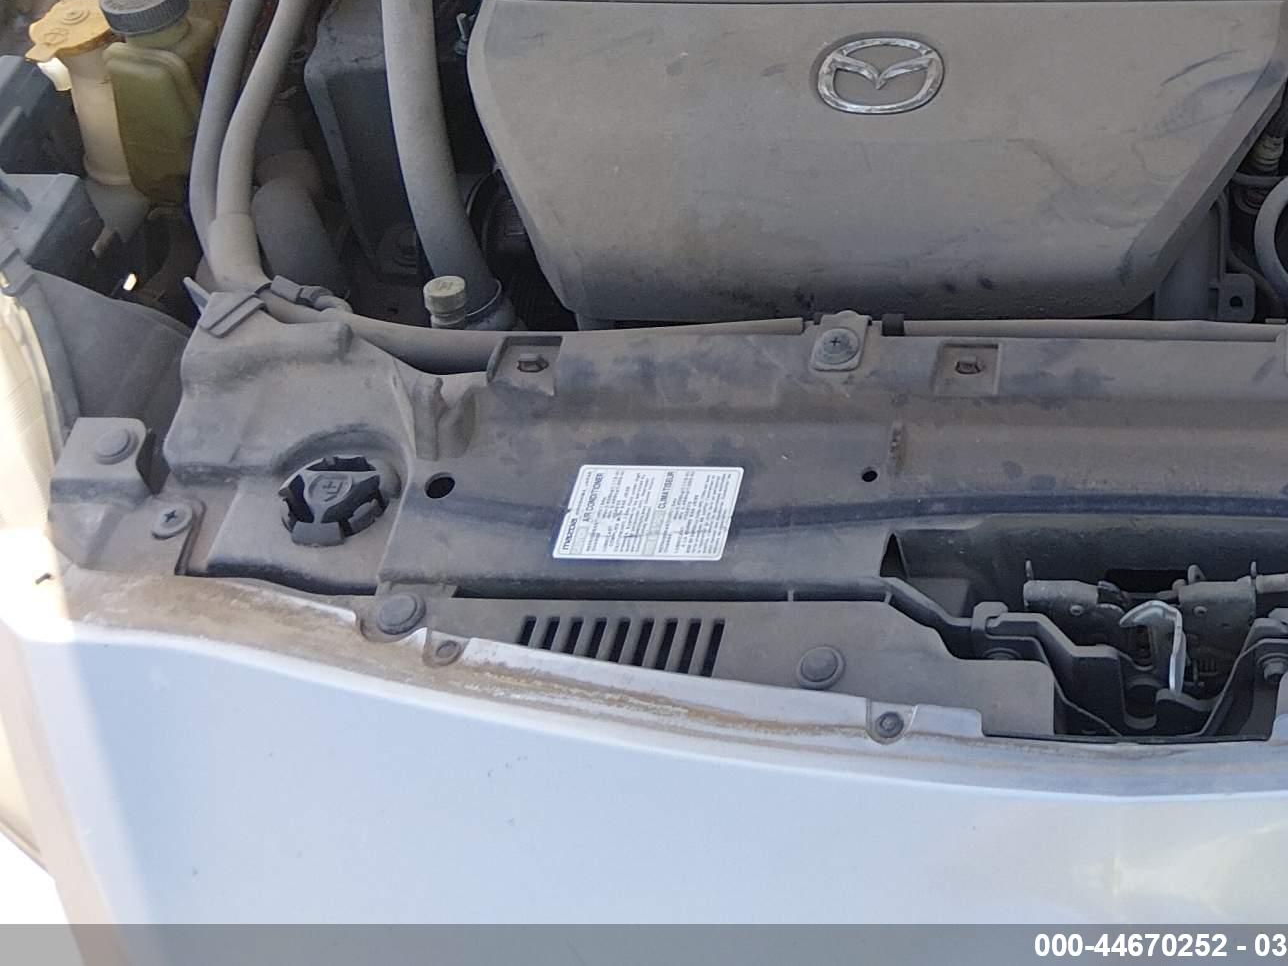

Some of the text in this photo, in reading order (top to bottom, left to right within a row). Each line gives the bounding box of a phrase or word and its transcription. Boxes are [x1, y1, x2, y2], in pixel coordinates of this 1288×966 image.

[586, 473, 604, 511] CONDITIONER
[658, 471, 674, 509] CLIMATISEUR
[562, 518, 578, 550] mazda
[582, 512, 592, 522] AIR
